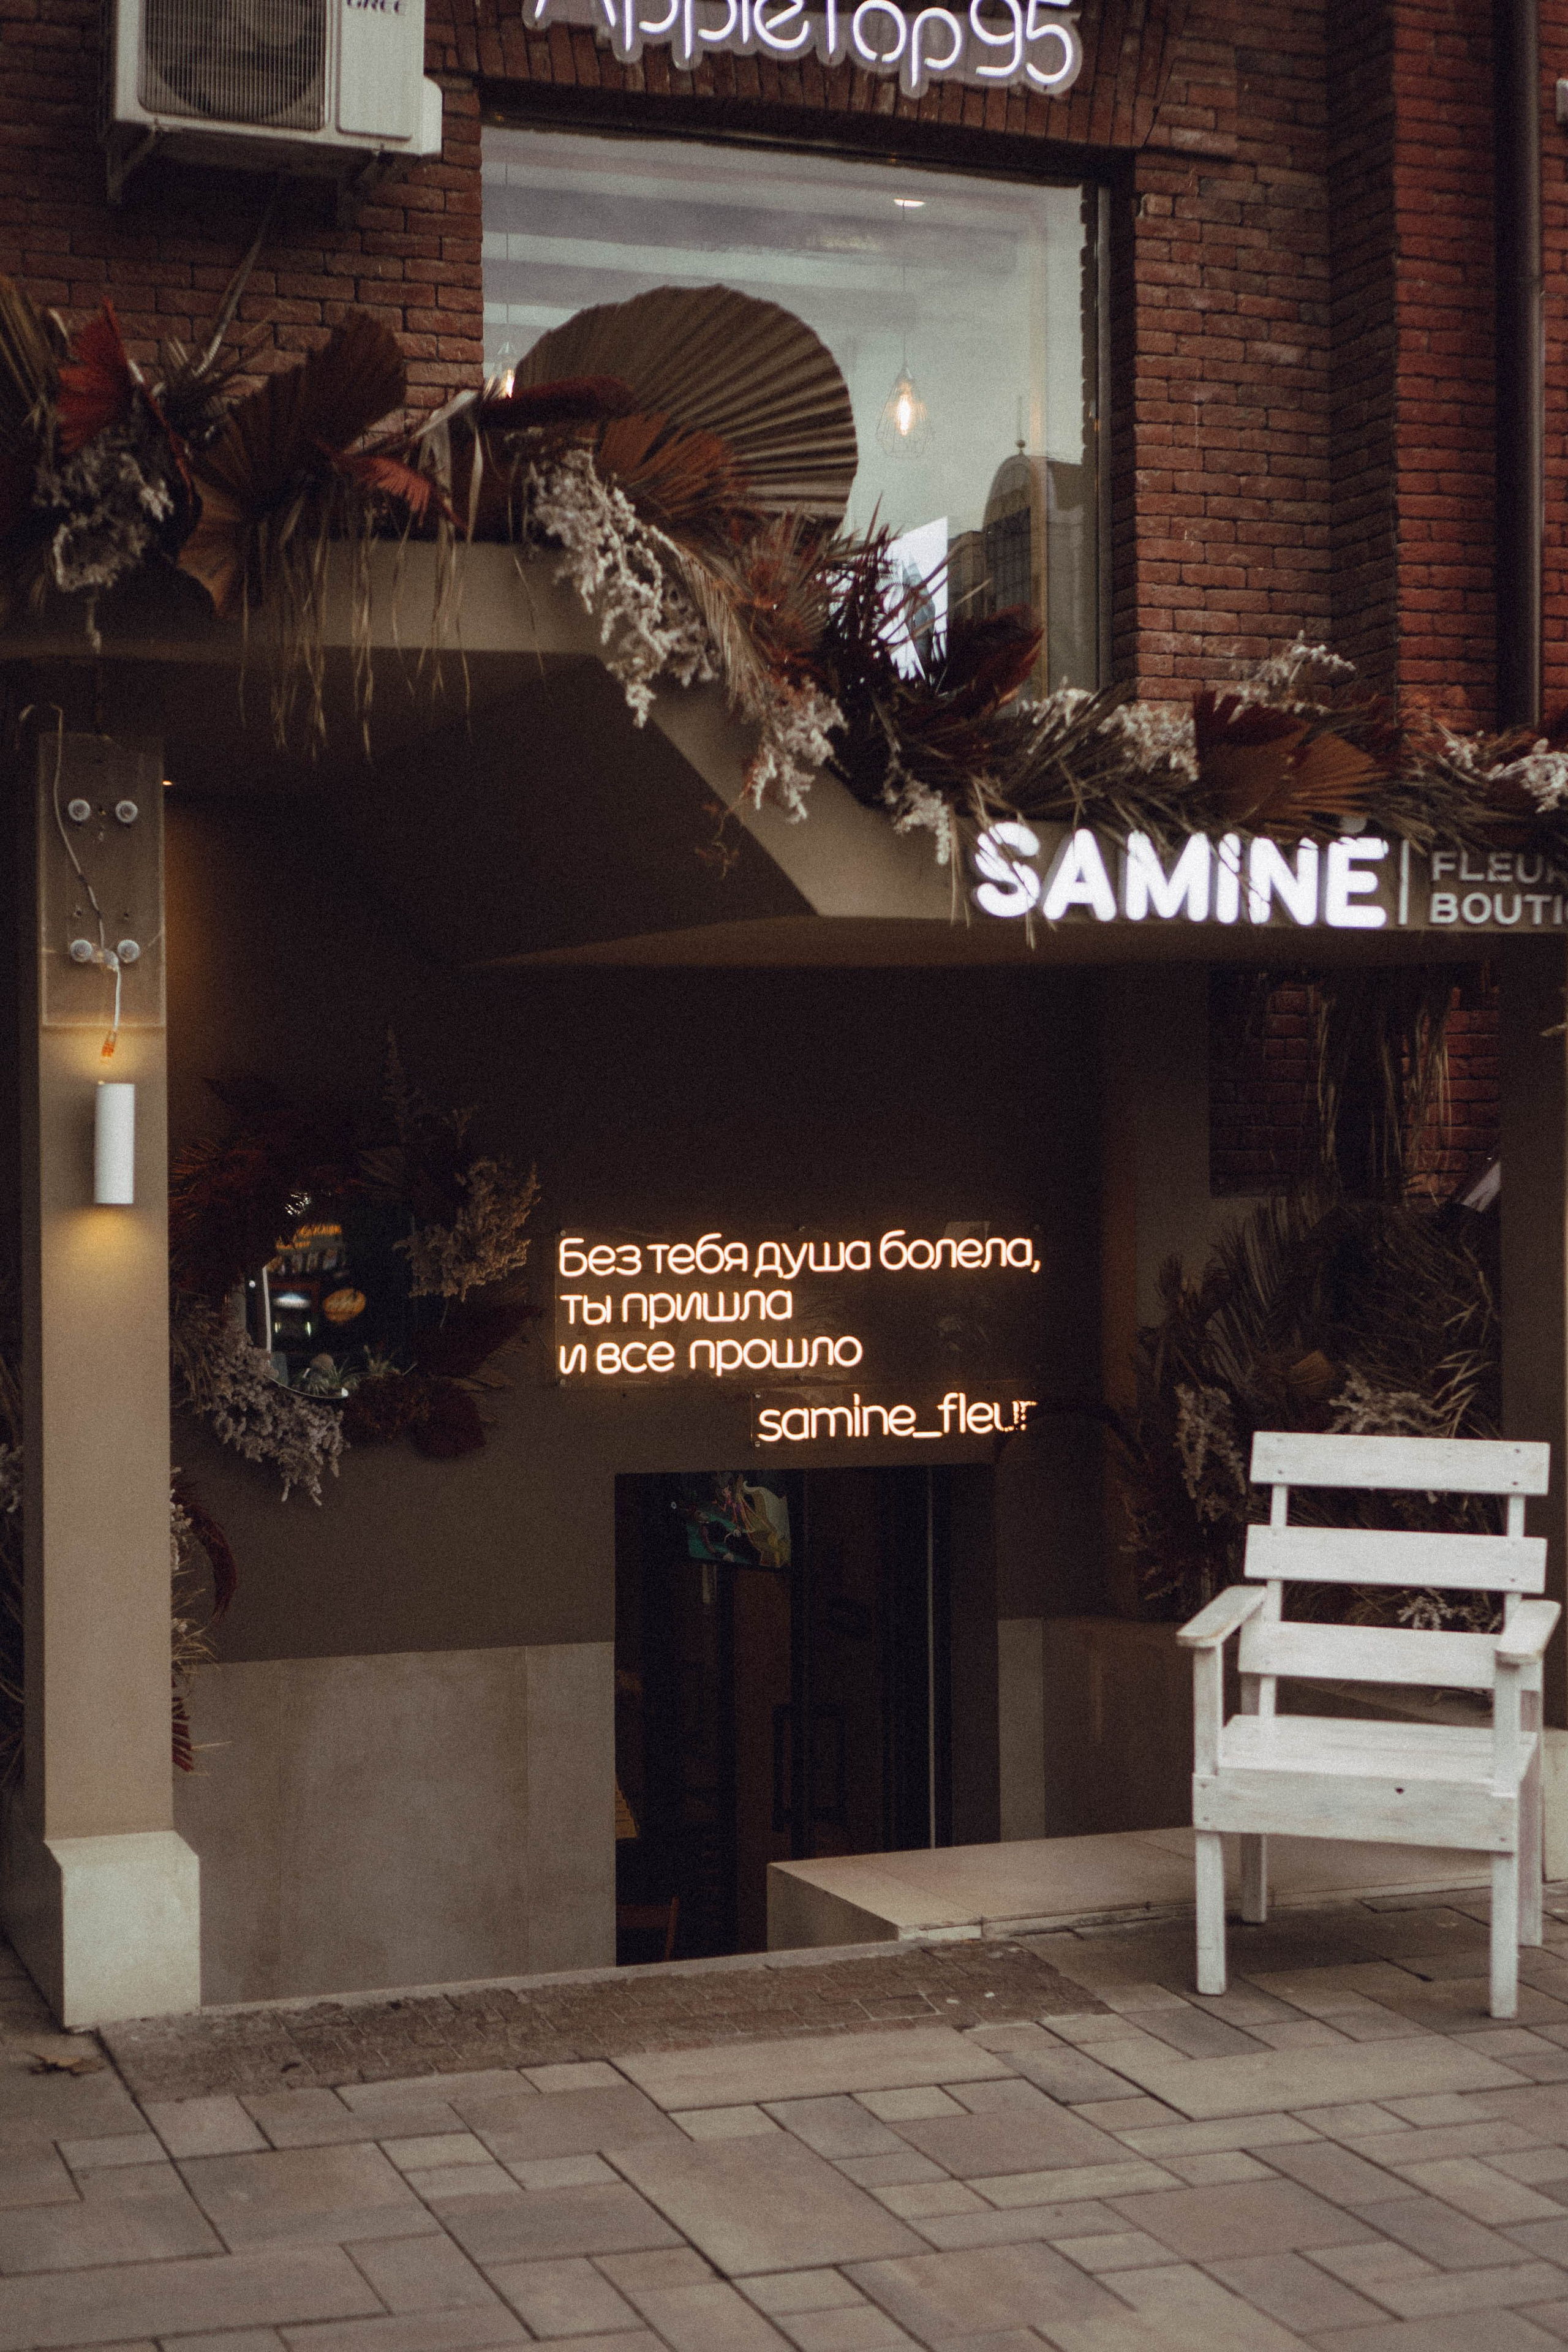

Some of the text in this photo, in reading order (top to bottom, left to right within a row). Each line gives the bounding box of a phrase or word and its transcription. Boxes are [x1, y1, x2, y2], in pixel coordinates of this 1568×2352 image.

[974, 821, 1390, 929] SAMINE
[1430, 892, 1568, 925] BOUTI
[558, 1229, 1041, 1280] Без тебя душа болела,
[559, 1289, 793, 1330] ты пришла
[558, 1335, 864, 1378] и все прошло
[757, 1392, 1038, 1442] samine_fleur
